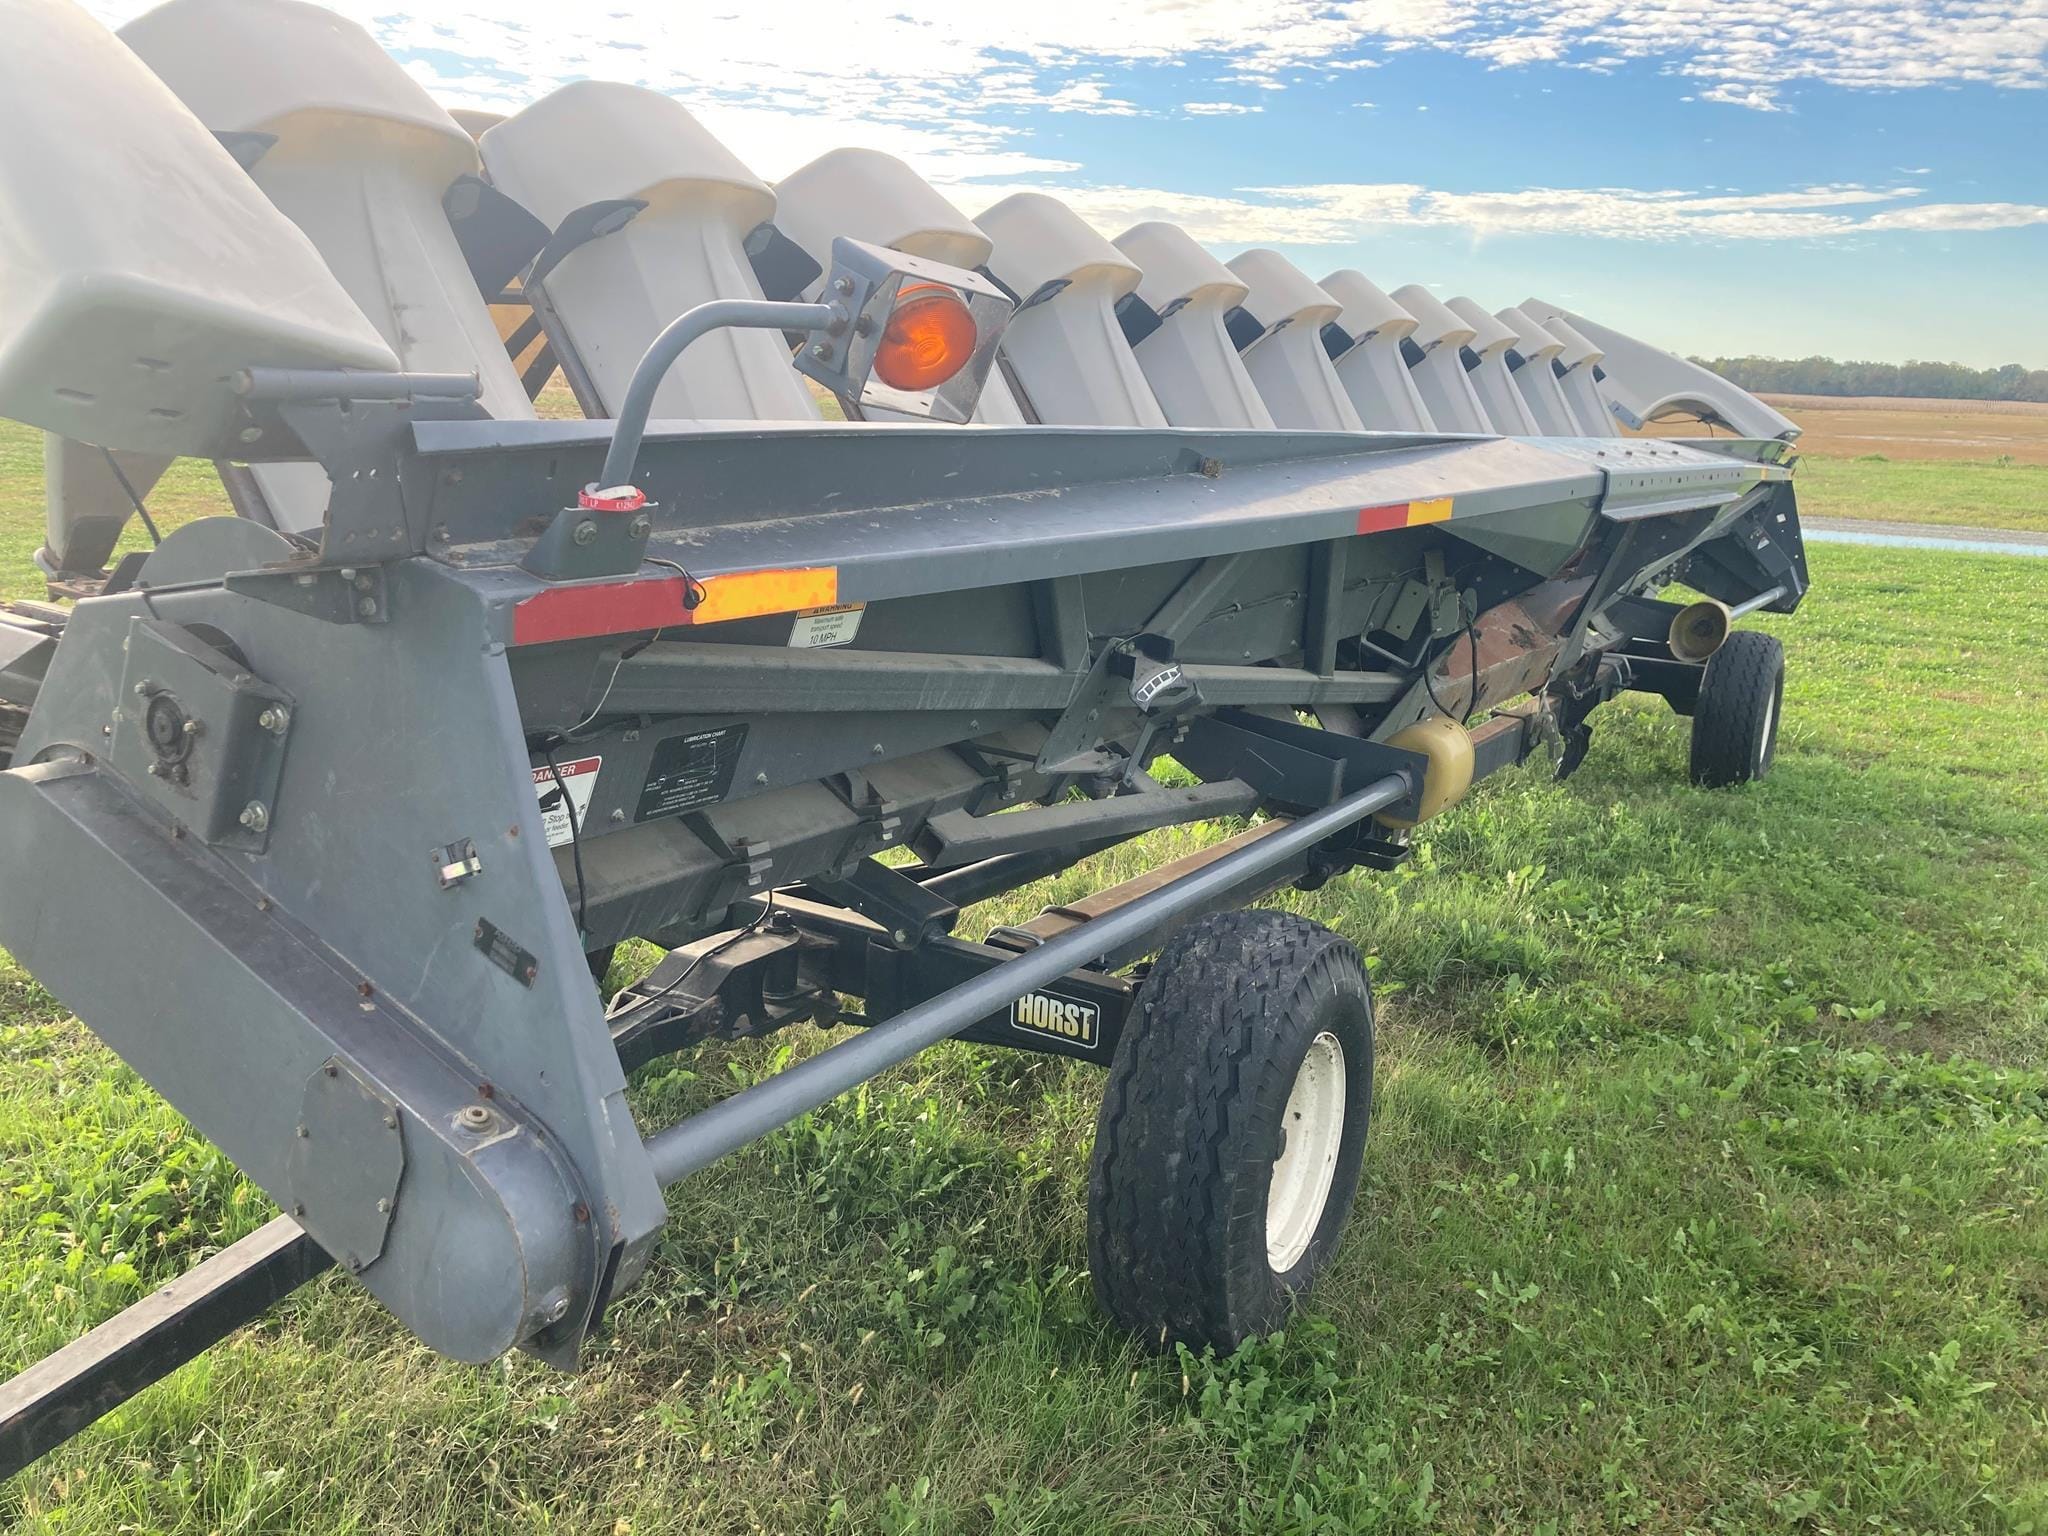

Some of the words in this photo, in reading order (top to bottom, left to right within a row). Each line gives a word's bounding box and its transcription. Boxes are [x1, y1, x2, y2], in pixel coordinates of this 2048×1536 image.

[809, 634, 819, 645] 10
[820, 632, 838, 643] MPH
[683, 734, 712, 743] LUBRICATION
[711, 730, 727, 739] CHART
[532, 765, 576, 782] DANER
[548, 813, 564, 824] Stop
[1018, 993, 1095, 1040] HORST
